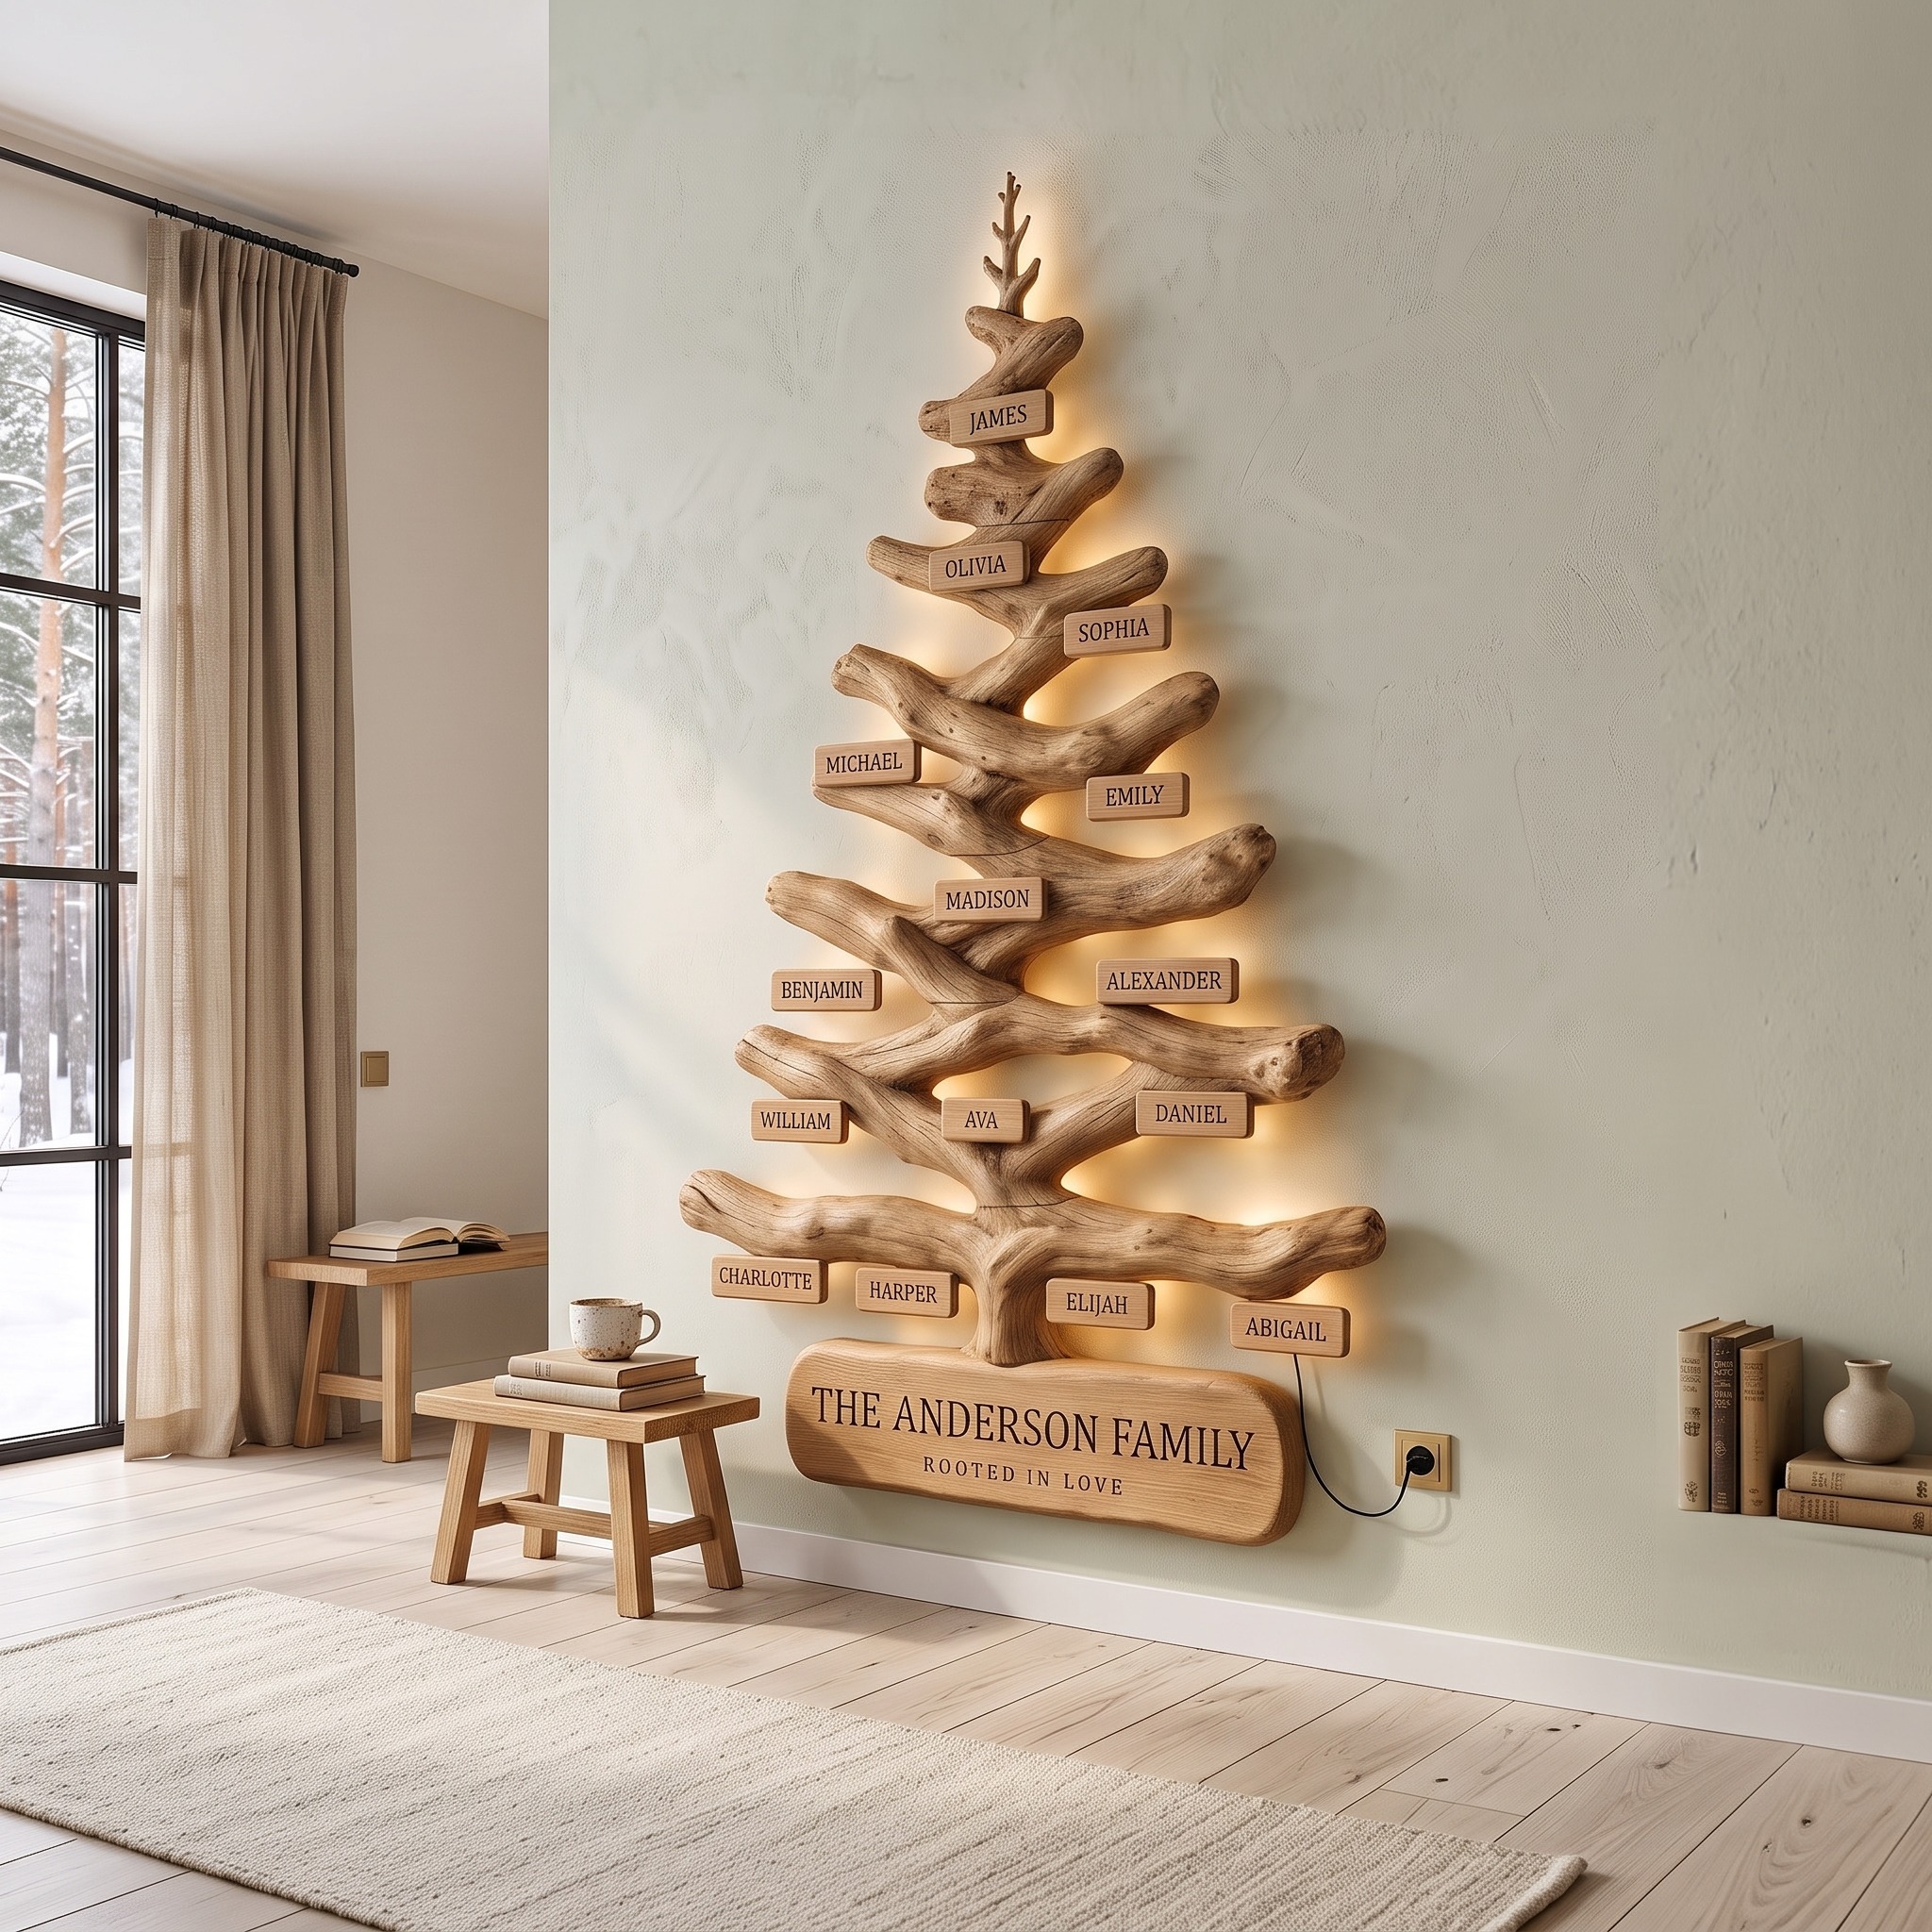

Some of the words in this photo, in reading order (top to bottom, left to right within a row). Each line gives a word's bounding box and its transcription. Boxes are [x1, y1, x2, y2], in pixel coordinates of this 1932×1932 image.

[969, 404, 1027, 436] JAMES
[945, 554, 1007, 578] OLIVIA
[1078, 617, 1150, 642] SOPHIA
[825, 752, 903, 774] MICHAEL
[1106, 784, 1165, 807] EMILY
[945, 889, 1030, 910] MADISON
[781, 980, 863, 1003] BENJAMIN
[1106, 971, 1223, 991] ALEXANDER
[760, 1111, 831, 1130] WILLIAM
[964, 1110, 999, 1129] AVA
[1155, 1104, 1227, 1124] DANIEL
[719, 1266, 813, 1291] CHARLOTTE
[869, 1281, 938, 1304] HARPER
[1066, 1292, 1128, 1317] ELIJAH
[1244, 1317, 1326, 1342] ABIGAIL
[811, 1386, 881, 1429] THE
[891, 1395, 1099, 1454] ANDERSON
[1111, 1417, 1256, 1471] FAMILY
[923, 1456, 1015, 1482] ROOTED
[1026, 1469, 1049, 1487] IN
[1063, 1473, 1123, 1496] LOVE
